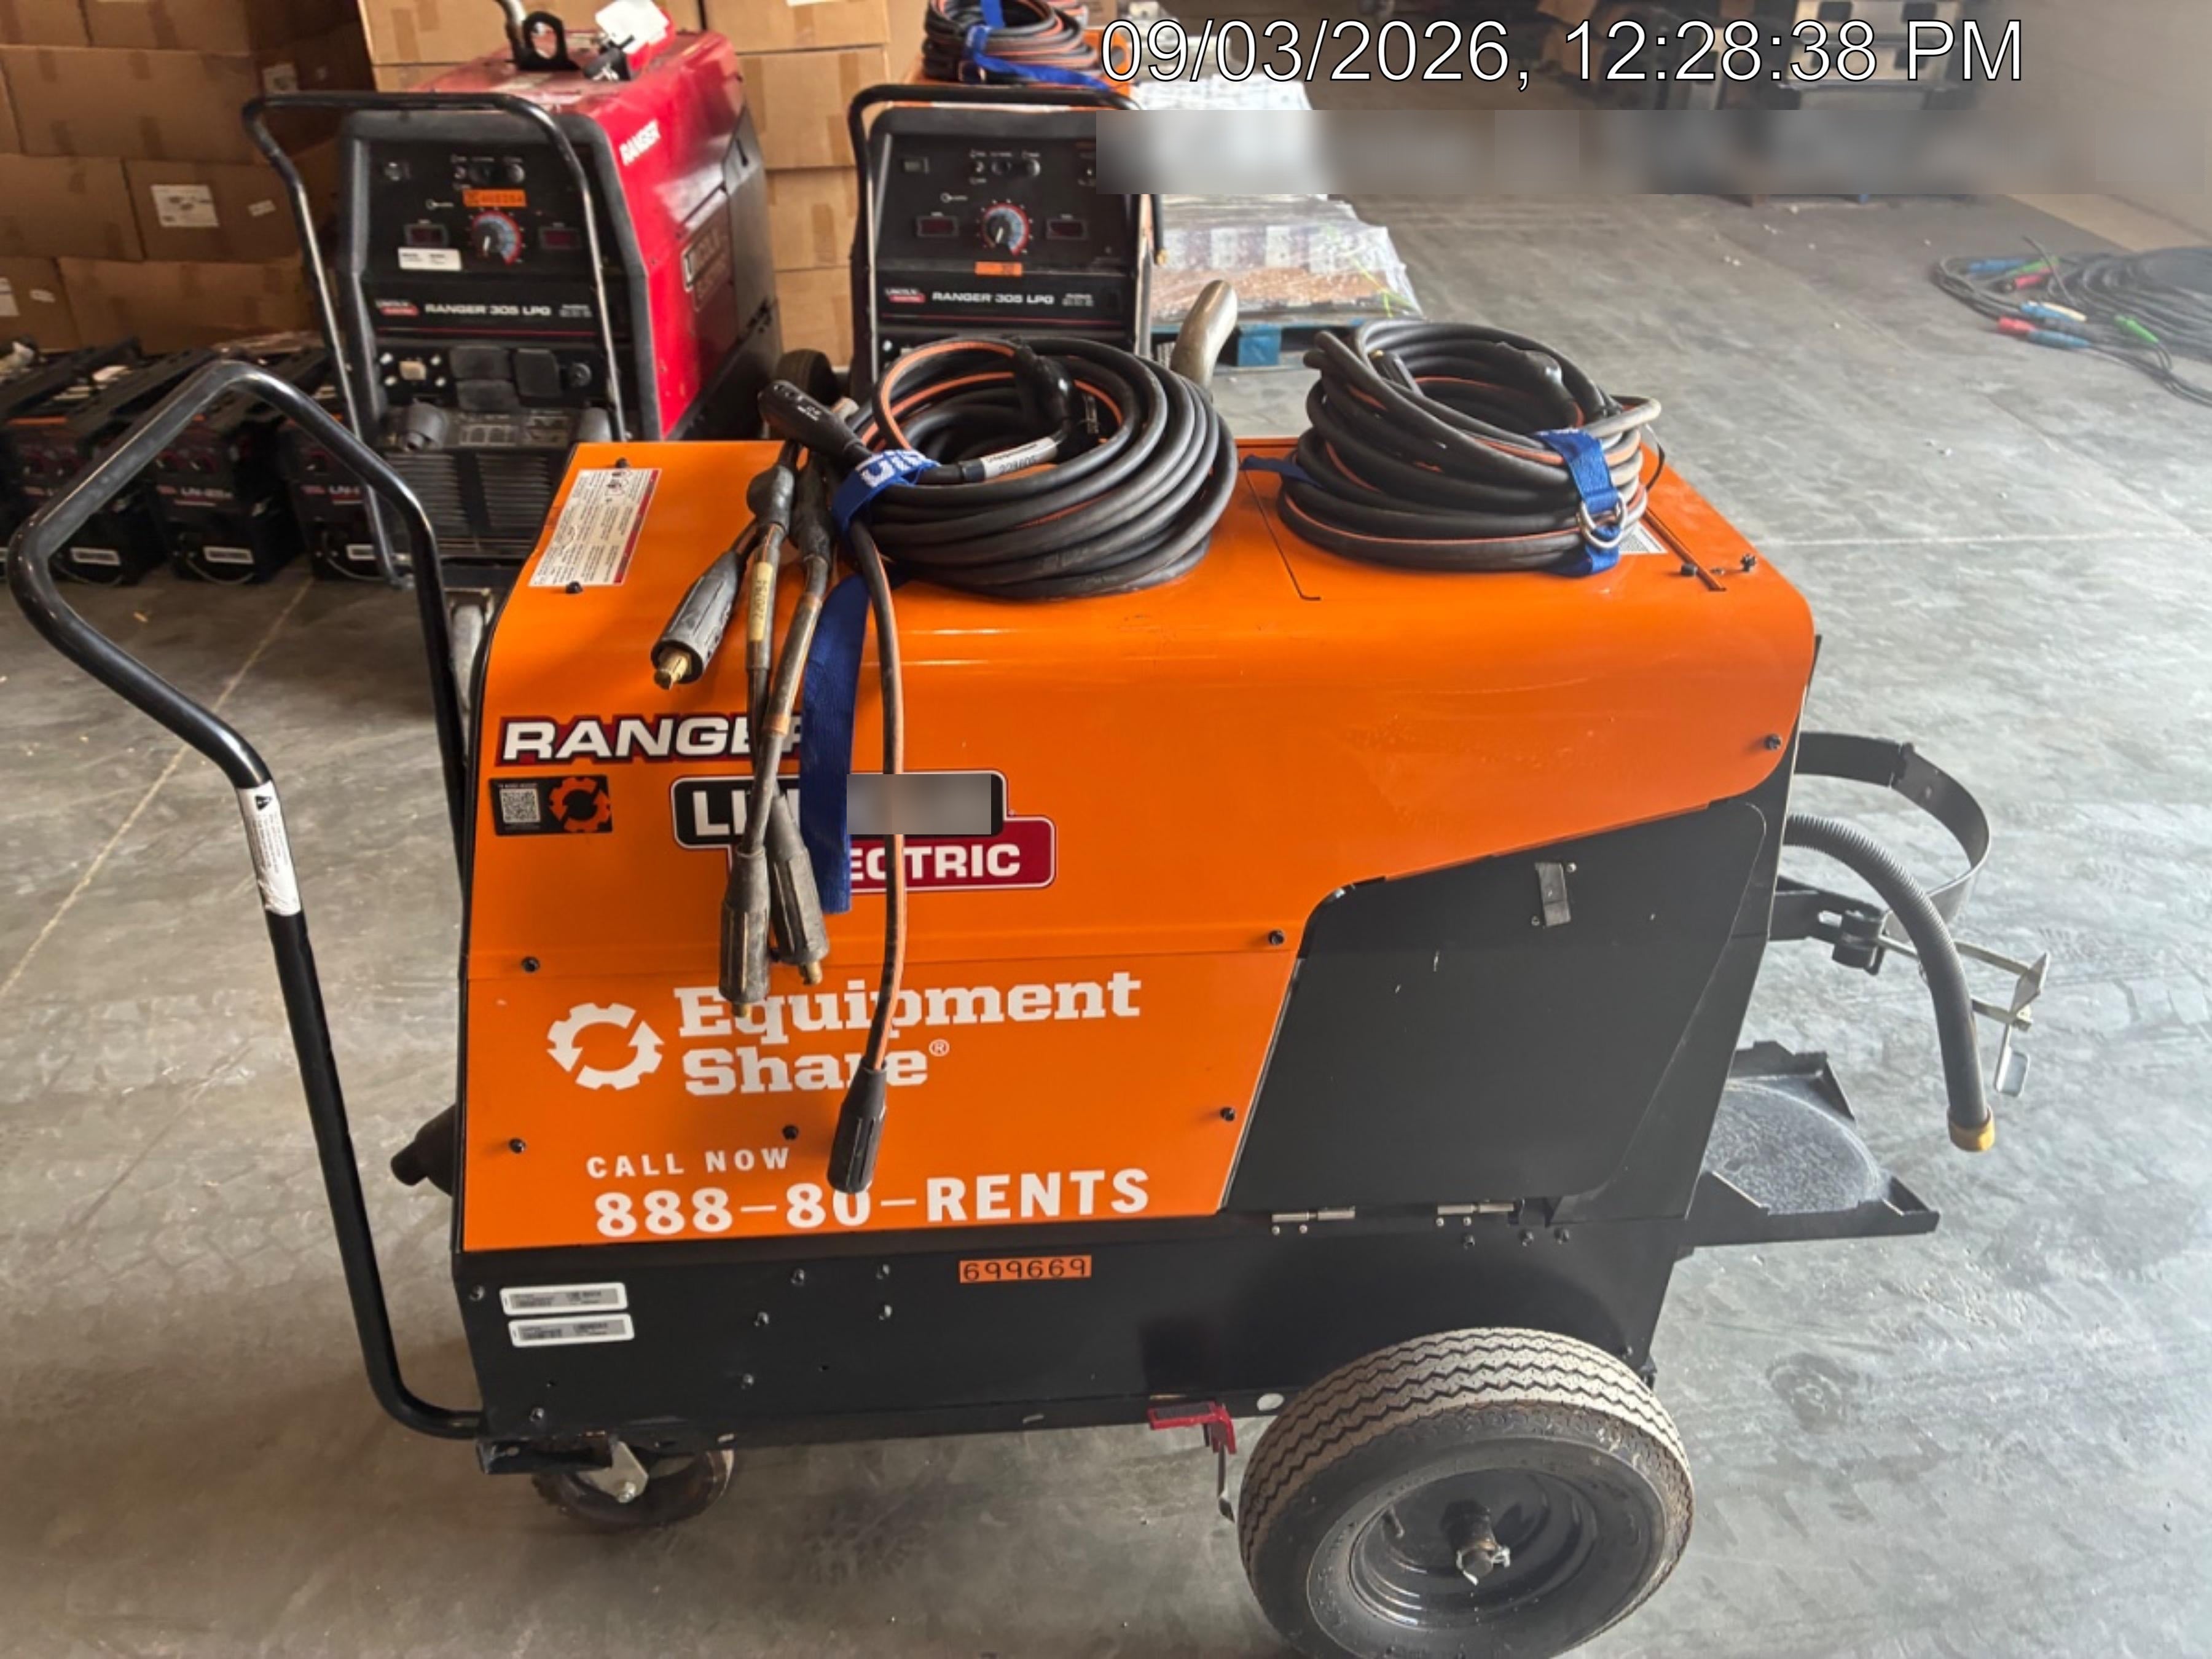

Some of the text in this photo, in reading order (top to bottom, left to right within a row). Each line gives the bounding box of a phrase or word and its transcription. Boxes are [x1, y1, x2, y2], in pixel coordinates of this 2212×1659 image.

[850, 843, 1021, 882] CTRIC
[674, 972, 1142, 1044] Equipment
[586, 1147, 791, 1179] CALL NOW
[963, 1257, 1086, 1282] 699669
